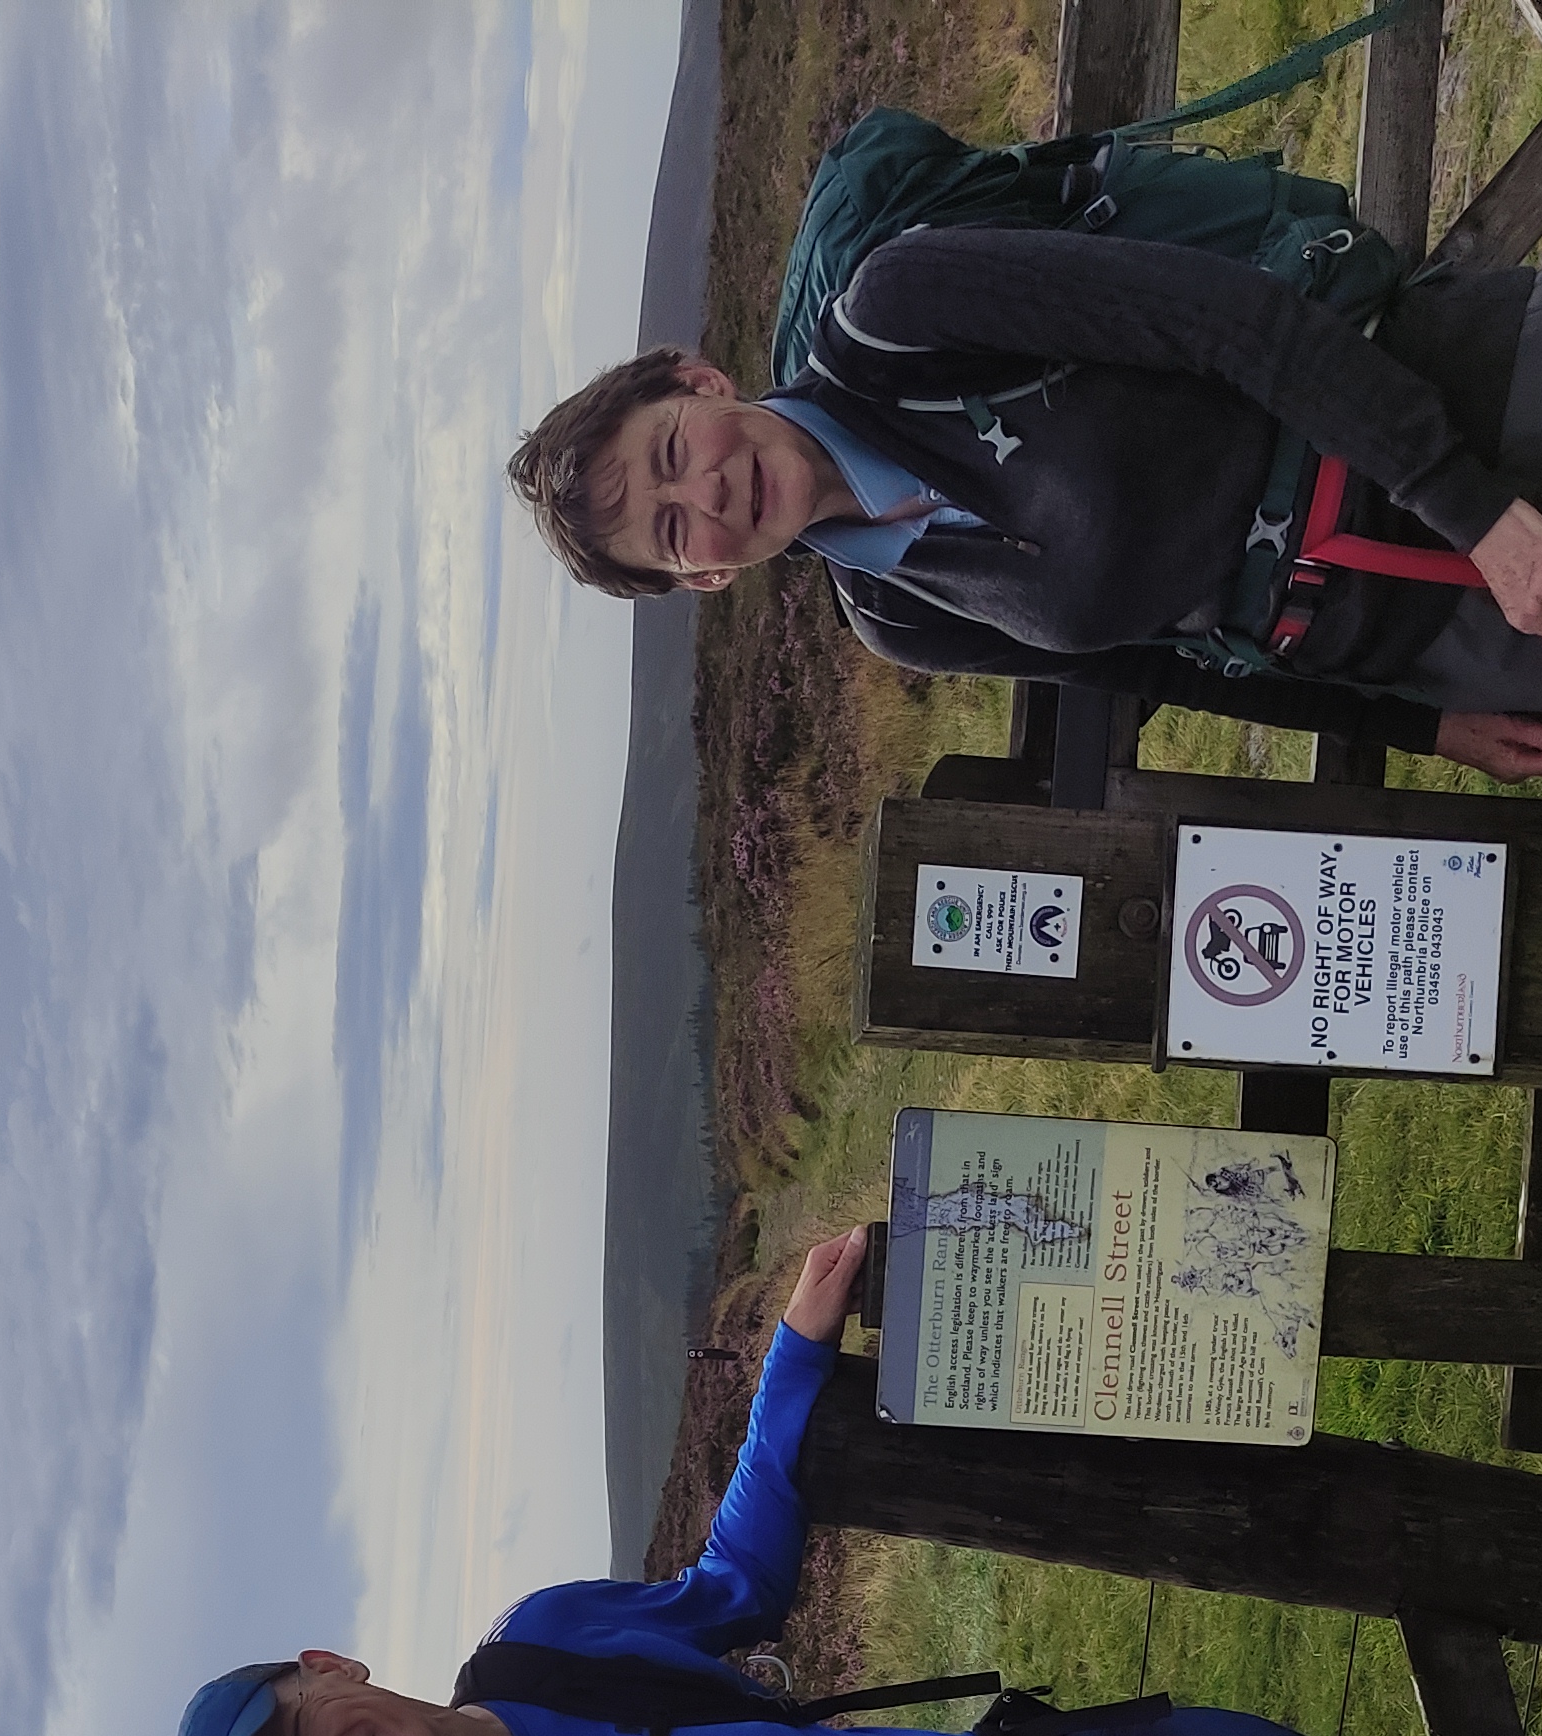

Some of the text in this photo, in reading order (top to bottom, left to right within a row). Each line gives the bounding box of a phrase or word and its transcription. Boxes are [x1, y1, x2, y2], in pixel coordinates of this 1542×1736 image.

[973, 883, 985, 957] IN AN EMERGENCY
[985, 903, 994, 940] CALL 999
[995, 891, 1006, 954] ASK FOR POLICE
[1005, 874, 1019, 972] THEN MOUNTAIN RESCUE
[1310, 851, 1337, 1048] NO RIGHT OF WAY
[1333, 882, 1357, 1014] FOR MOTOR
[1354, 899, 1376, 1007] VEHICLES
[1382, 854, 1405, 1055] To report illegal motor vehicle
[1398, 849, 1420, 1059] use of this path please contact
[1411, 876, 1432, 1035] Northumbria Police on
[1427, 907, 1444, 1005] 03456 043043
[990, 1158, 1003, 1178] sign
[983, 1247, 994, 1264] the
[944, 1160, 973, 1409] English access legislation is different from that in
[958, 1151, 987, 1410] Scotland. Please keep to waymarked footpaths and
[984, 1267, 993, 1285] see
[983, 1288, 993, 1308] you
[988, 1175, 1015, 1412] which indicates that walkers are free to roam.
[1093, 1190, 1133, 1421] Clennell Street
[1154, 1305, 1160, 1313] as
[926, 1279, 946, 1368] Otterburn
[979, 1310, 990, 1342] unless
[1150, 1314, 1159, 1338] known
[1181, 1313, 1189, 1328] 16th
[979, 1344, 990, 1365] way
[1149, 1353, 1158, 1380] crossing
[1178, 1344, 1187, 1359] 15th
[976, 1366, 986, 1379] of
[1014, 1339, 1028, 1414] Otterburn Ranges
[923, 1374, 939, 1408] The
[974, 1382, 987, 1411] rights
[1145, 1381, 1154, 1405] border
[1176, 1382, 1184, 1398] here
[1144, 1406, 1152, 1420] This
[1175, 1399, 1183, 1423] around
